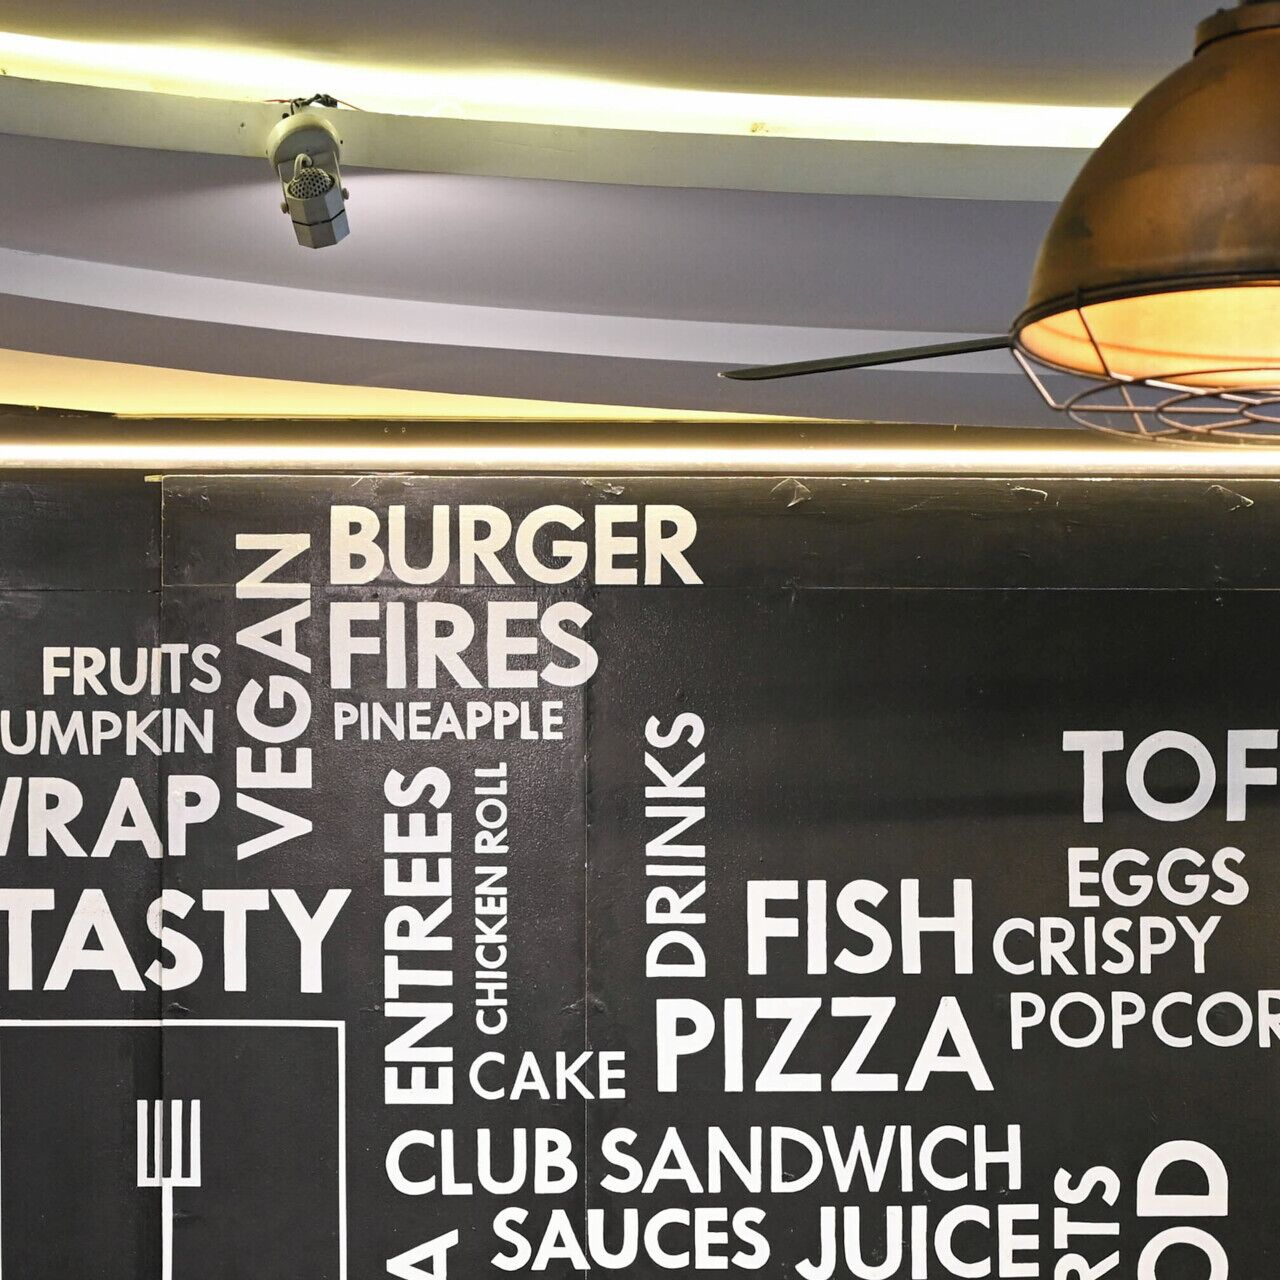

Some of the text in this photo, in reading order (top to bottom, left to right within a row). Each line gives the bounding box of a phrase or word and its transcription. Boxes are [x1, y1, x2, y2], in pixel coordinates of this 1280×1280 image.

[329, 504, 703, 585] BURGER
[42, 643, 221, 695] FRUITS
[329, 600, 599, 690] FIRES
[235, 532, 313, 861] VEGAN
[334, 701, 564, 741] PINEAPPLE
[644, 712, 706, 978] DRINKS
[1067, 846, 1250, 908] EGGS
[383, 766, 454, 1105] ENTREES
[475, 761, 508, 1035] CHICKEN ROLL
[746, 878, 974, 976] FISH
[992, 915, 1221, 976] CRISPY
[468, 1050, 626, 1101] CAKE
[655, 996, 994, 1093] PIZZA
[385, 1124, 1022, 1196] CLUB SANDWICH
[491, 1206, 771, 1272] SAUCES
